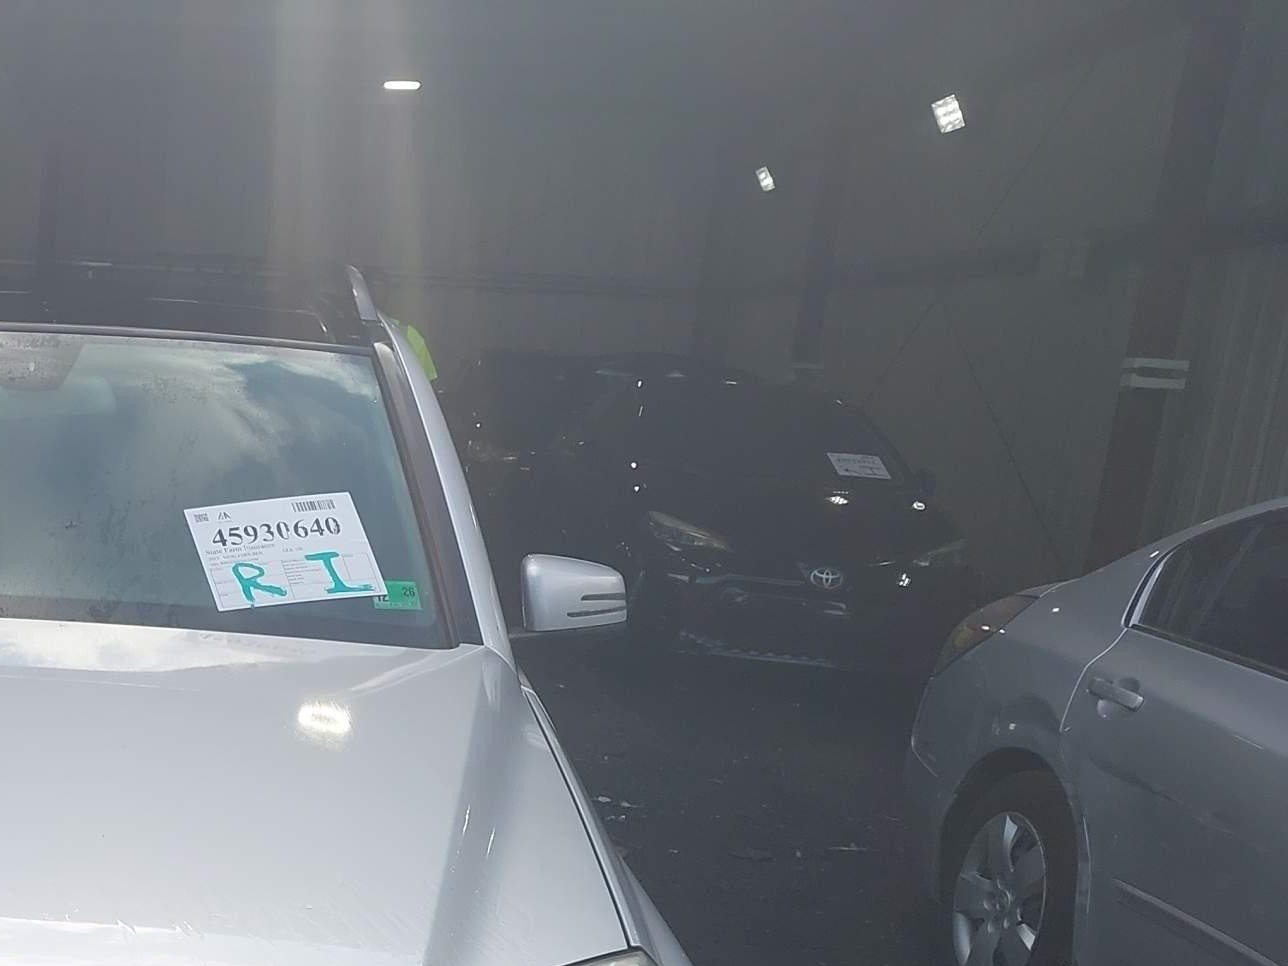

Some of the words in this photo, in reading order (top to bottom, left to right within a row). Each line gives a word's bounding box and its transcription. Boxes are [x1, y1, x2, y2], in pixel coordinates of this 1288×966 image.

[212, 516, 341, 547] 45930640
[231, 562, 288, 606] R
[304, 551, 376, 594] I
